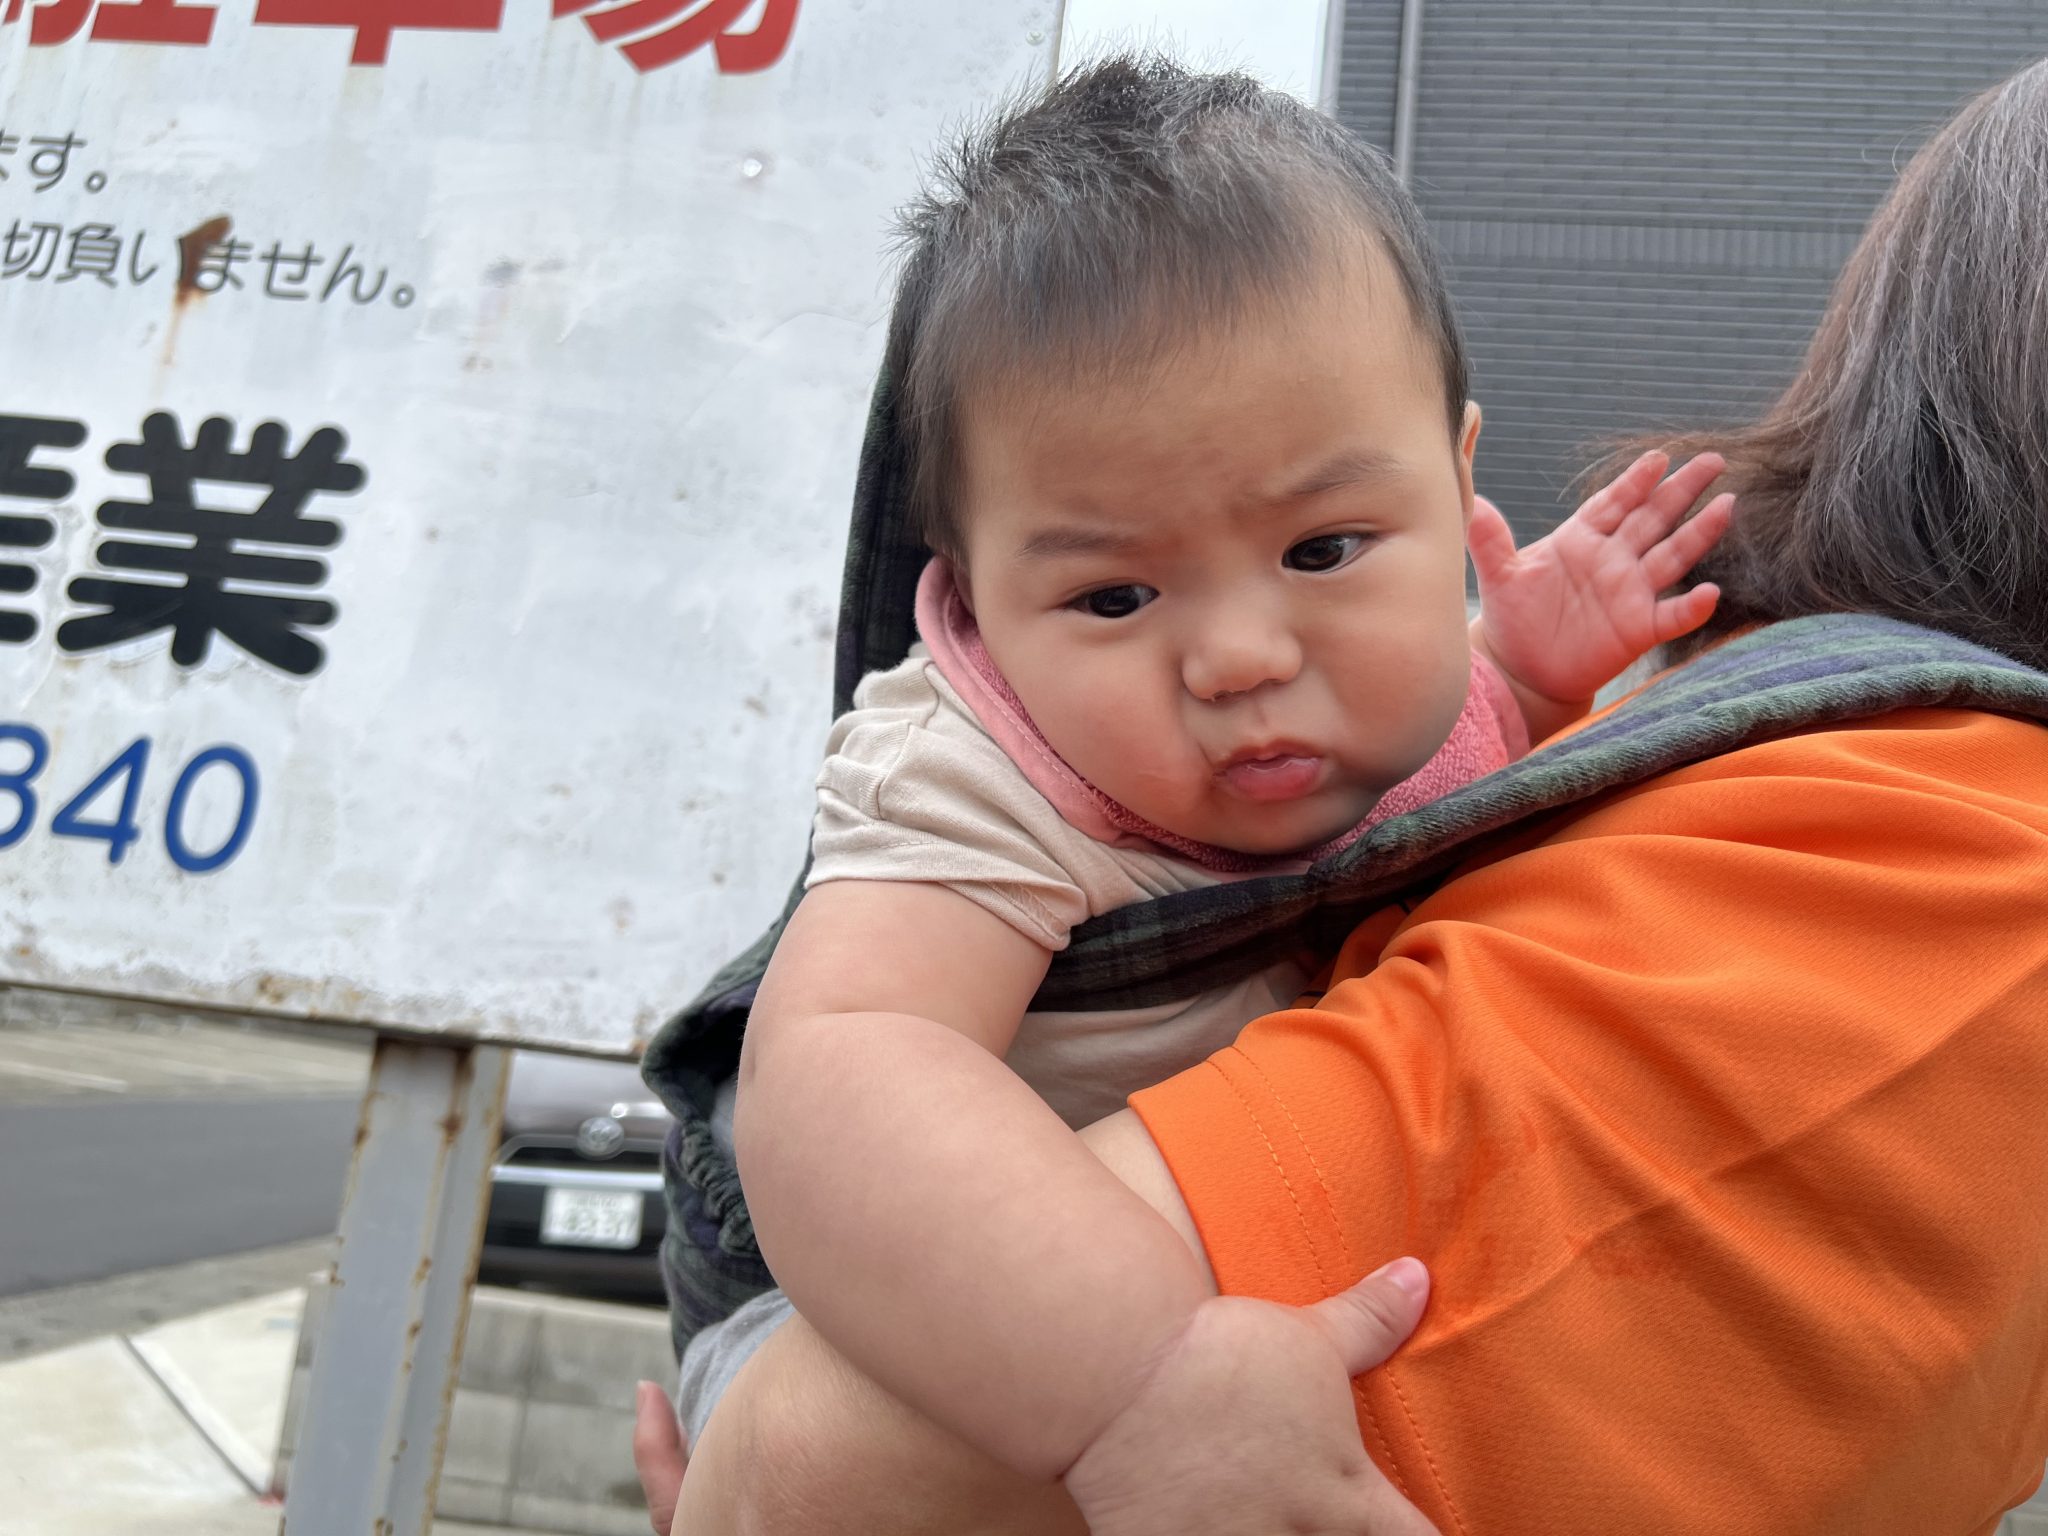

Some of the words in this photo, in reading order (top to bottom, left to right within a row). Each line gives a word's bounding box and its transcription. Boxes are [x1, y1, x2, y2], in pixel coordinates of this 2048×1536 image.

[2, 218, 414, 308] 切負いません。
